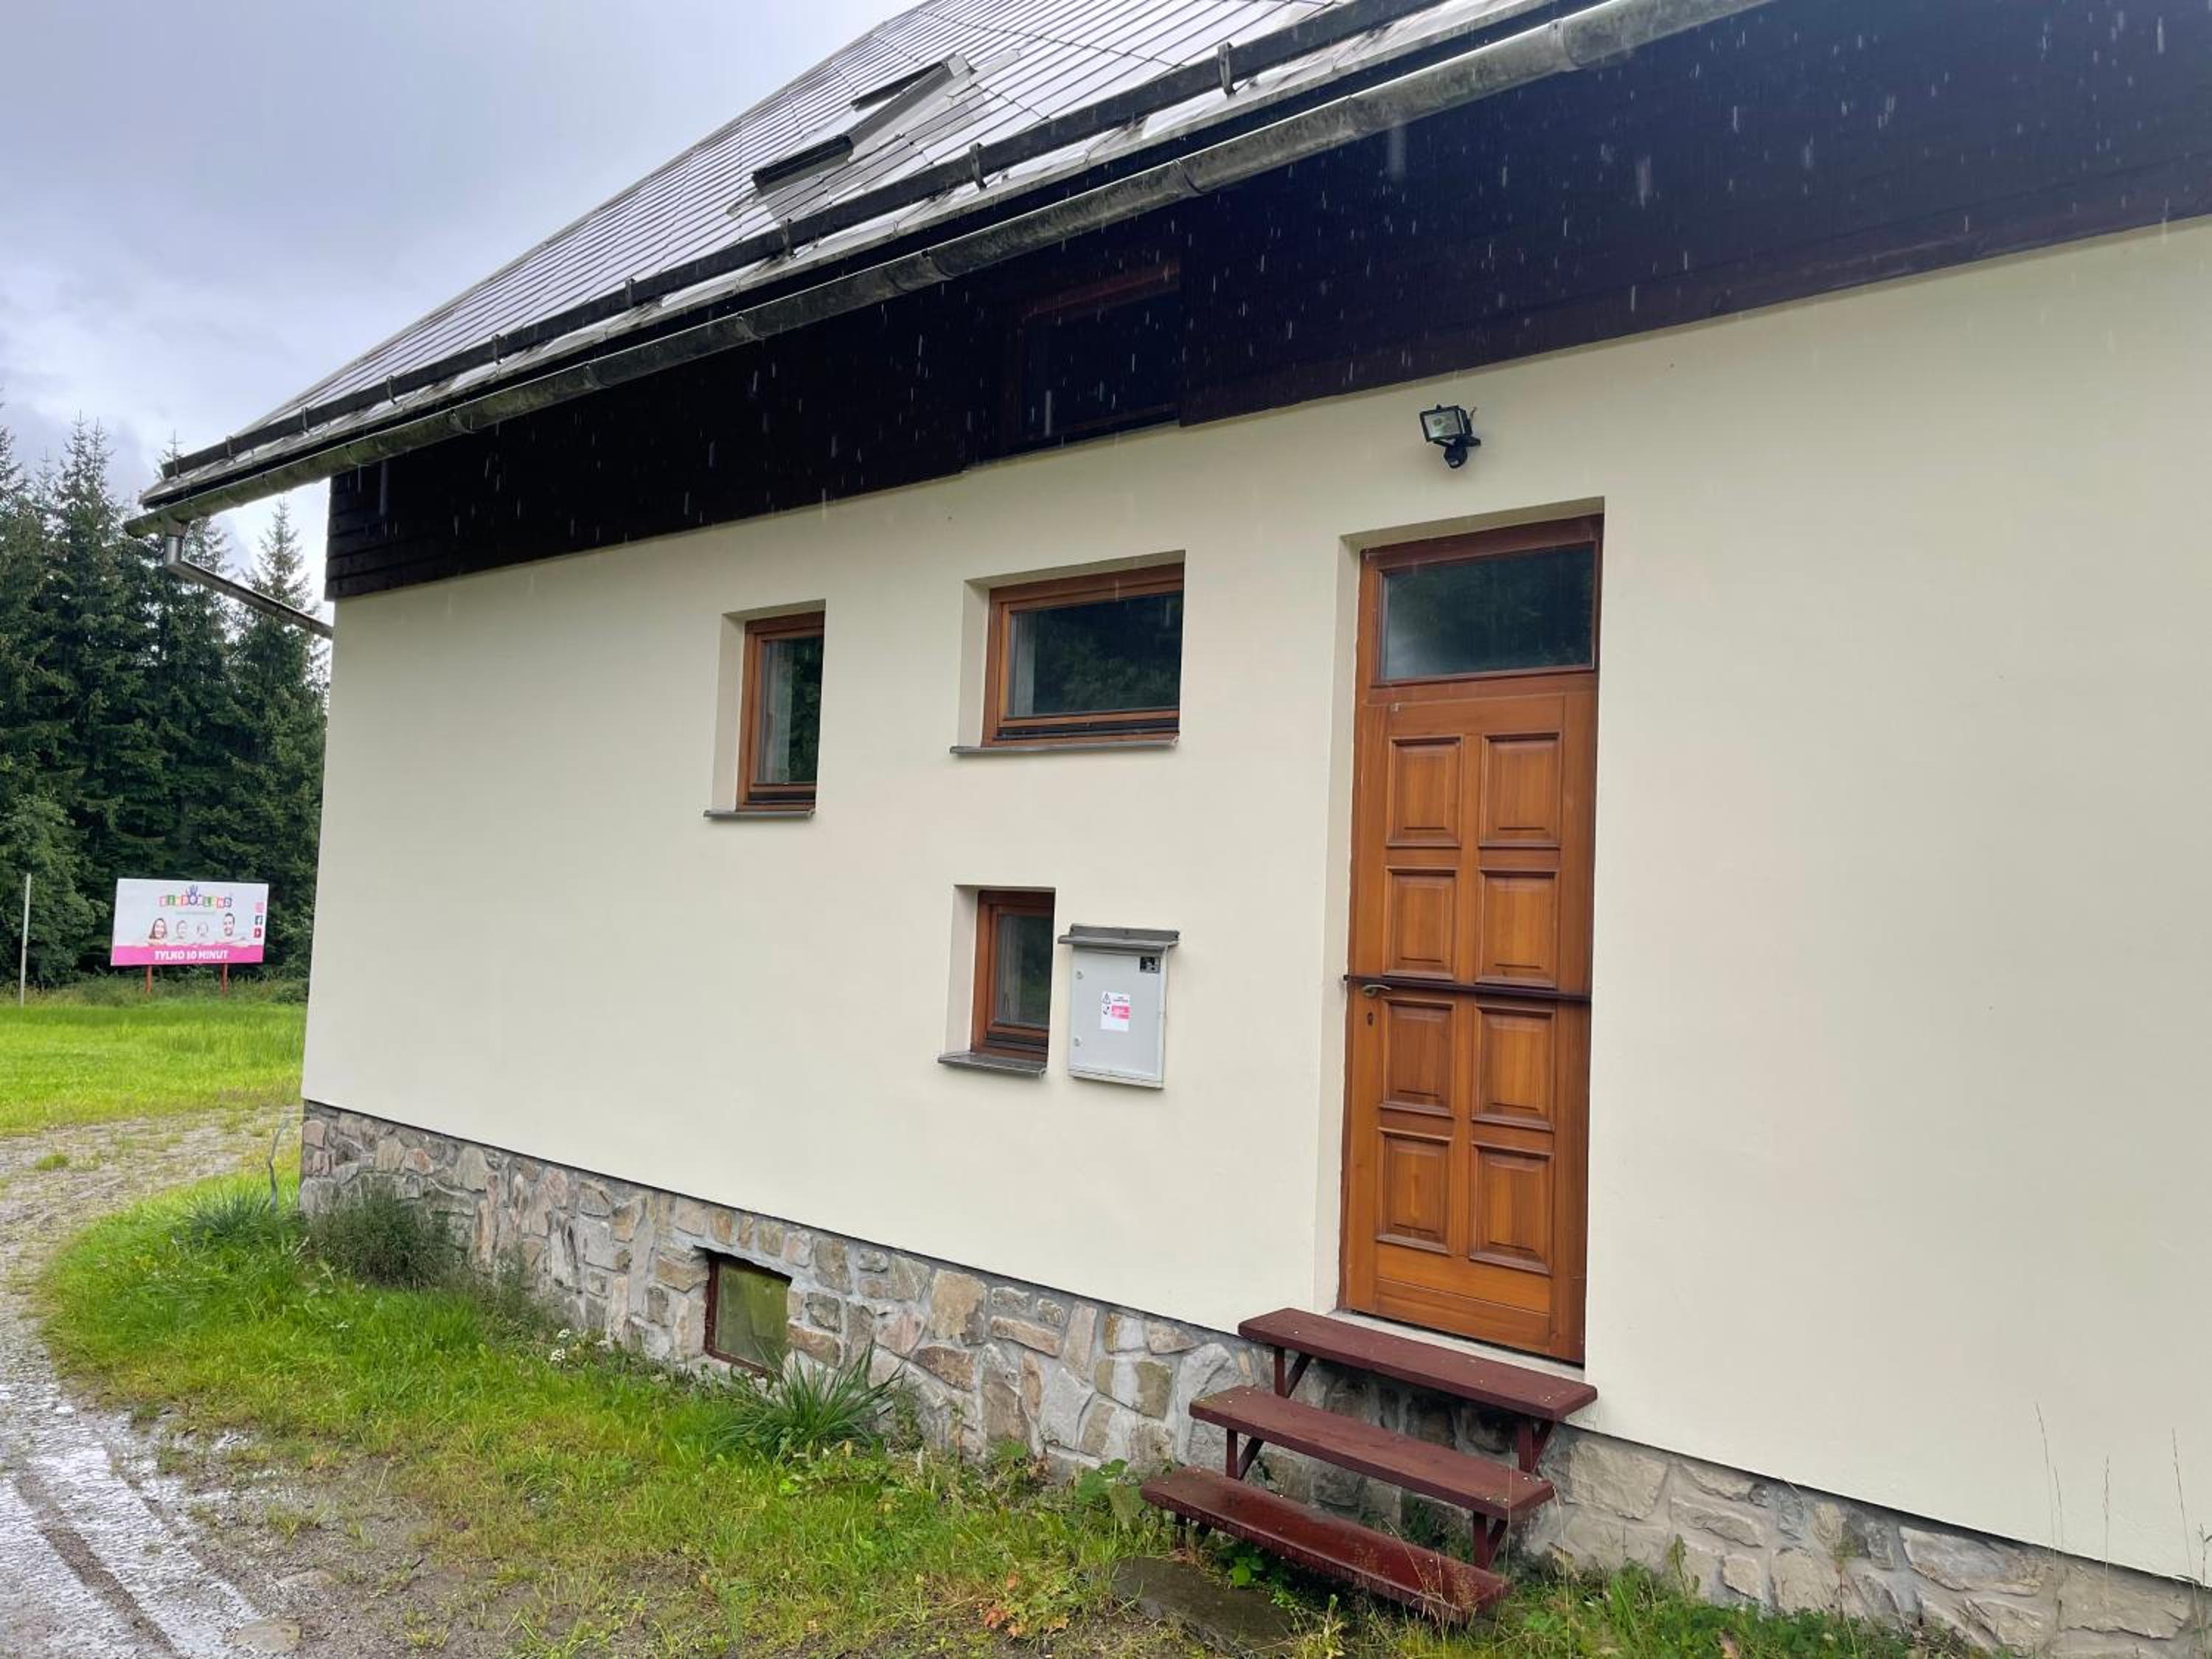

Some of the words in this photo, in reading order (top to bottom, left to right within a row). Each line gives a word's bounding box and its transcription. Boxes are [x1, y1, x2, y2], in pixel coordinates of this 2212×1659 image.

[154, 950, 185, 961] TYLKO
[187, 950, 197, 960] 10
[198, 949, 228, 959] MINUT
